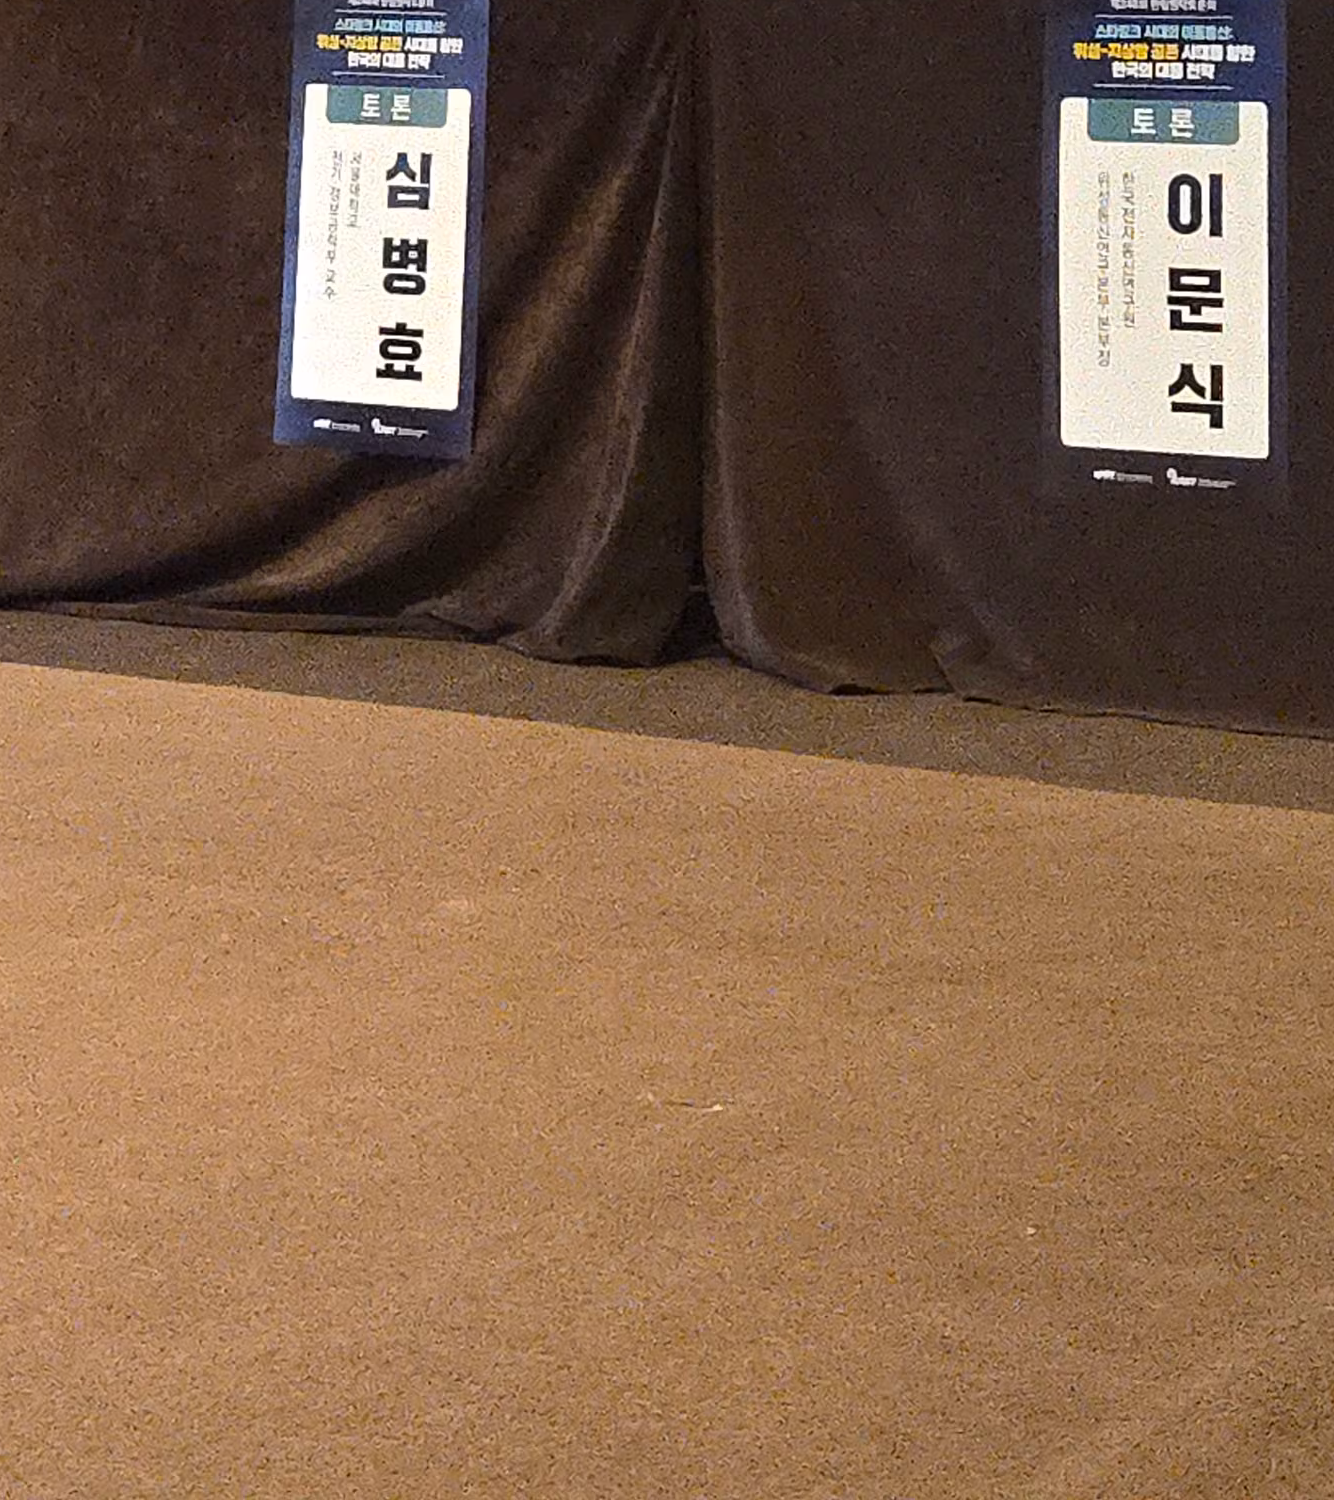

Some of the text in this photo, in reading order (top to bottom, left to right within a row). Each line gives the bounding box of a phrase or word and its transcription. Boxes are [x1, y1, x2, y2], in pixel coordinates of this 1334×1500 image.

[360, 92, 412, 122] 토론
[1130, 107, 1195, 139] 토론
[375, 151, 434, 382] 심병효
[1166, 172, 1225, 431] 이문식
